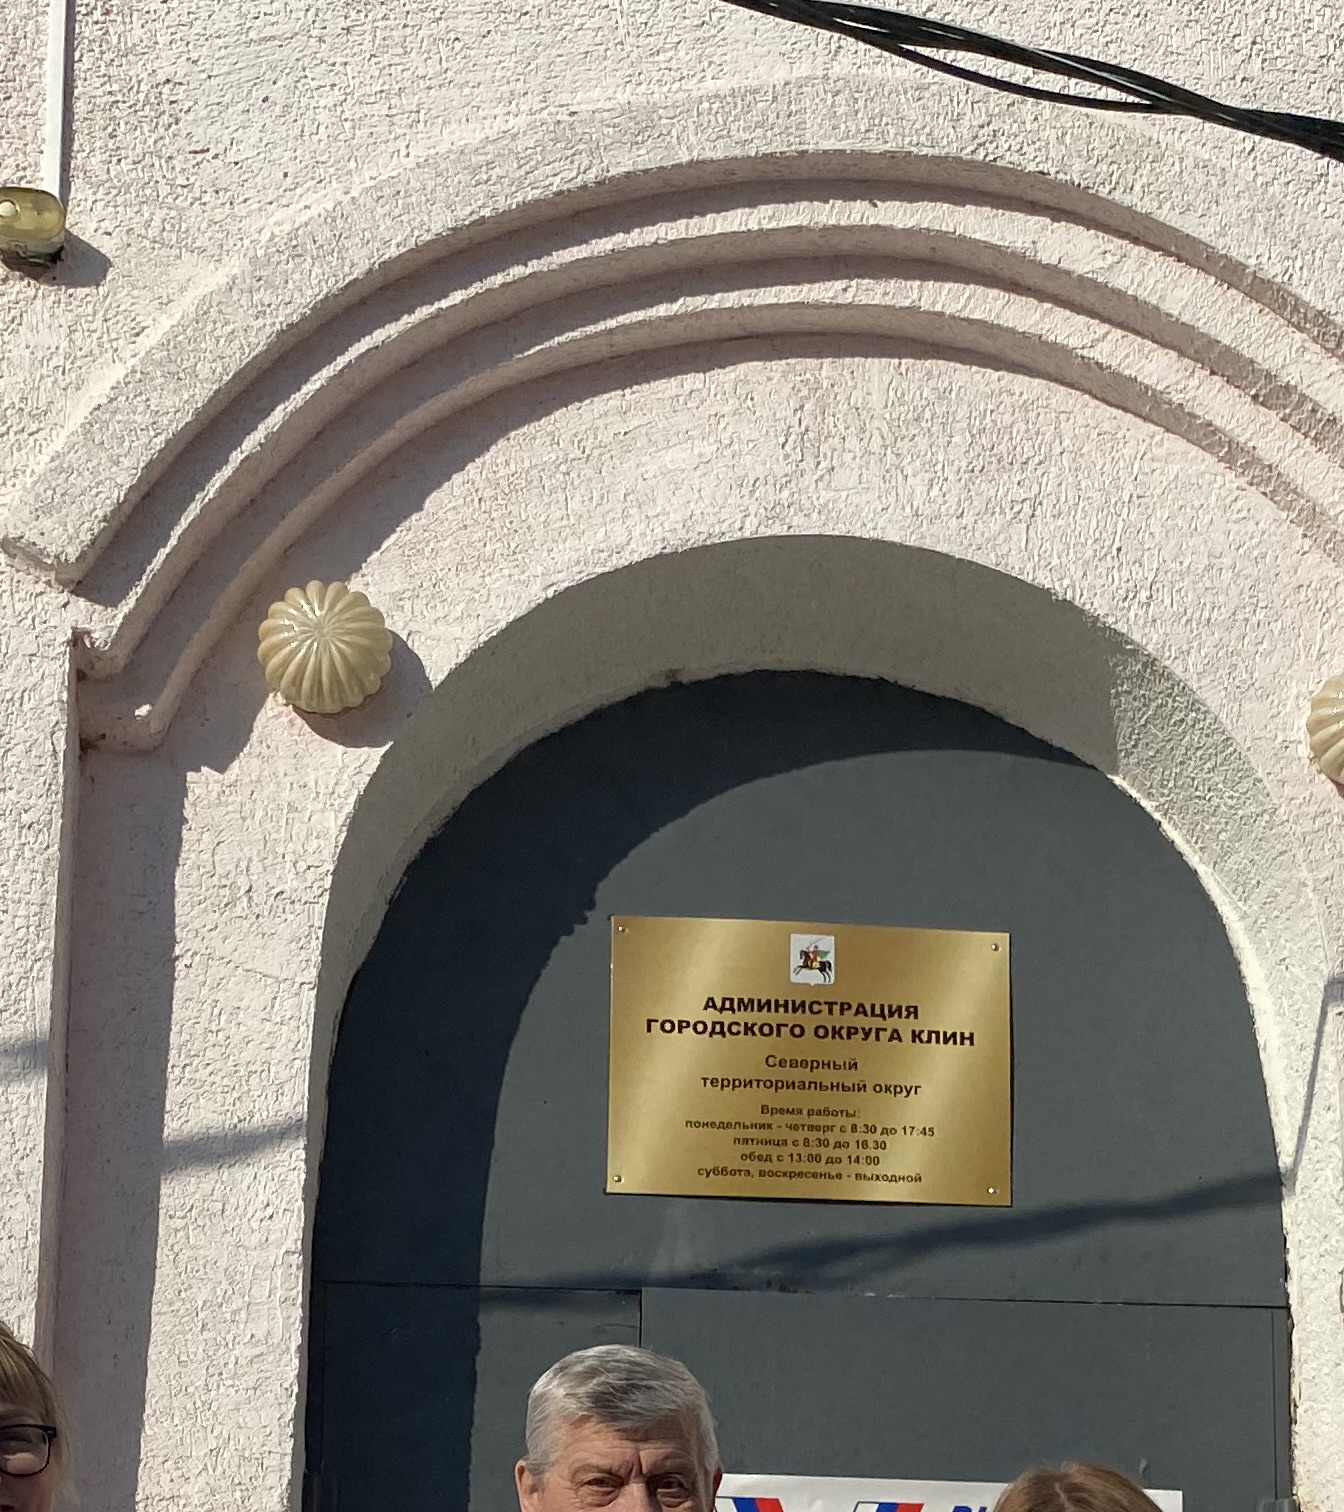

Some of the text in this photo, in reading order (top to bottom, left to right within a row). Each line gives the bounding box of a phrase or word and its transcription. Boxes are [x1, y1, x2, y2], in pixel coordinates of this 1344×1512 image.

[703, 997, 919, 1021] АДМИНИСТРАЦИЯ
[646, 1018, 975, 1047] ГОРОДСКОГО ОКРУГА КЛИН
[764, 1054, 858, 1073] Северный
[700, 1076, 922, 1098] территориальный округ
[760, 1104, 861, 1119] Время работы:
[685, 1119, 774, 1131] понедельник
[784, 1122, 836, 1134] четверг
[839, 1125, 847, 1134] с
[850, 1123, 877, 1135] 8:30
[880, 1127, 898, 1137] до
[902, 1125, 935, 1138] 17:45
[733, 1137, 788, 1149] пятница
[792, 1139, 799, 1147] с
[803, 1137, 830, 1148] 8:30
[833, 1140, 850, 1150] до
[740, 1152, 880, 1166] обед с 13:00 до 14:00
[758, 1169, 843, 1181] воскресенье
[854, 1171, 923, 1184] выходной
